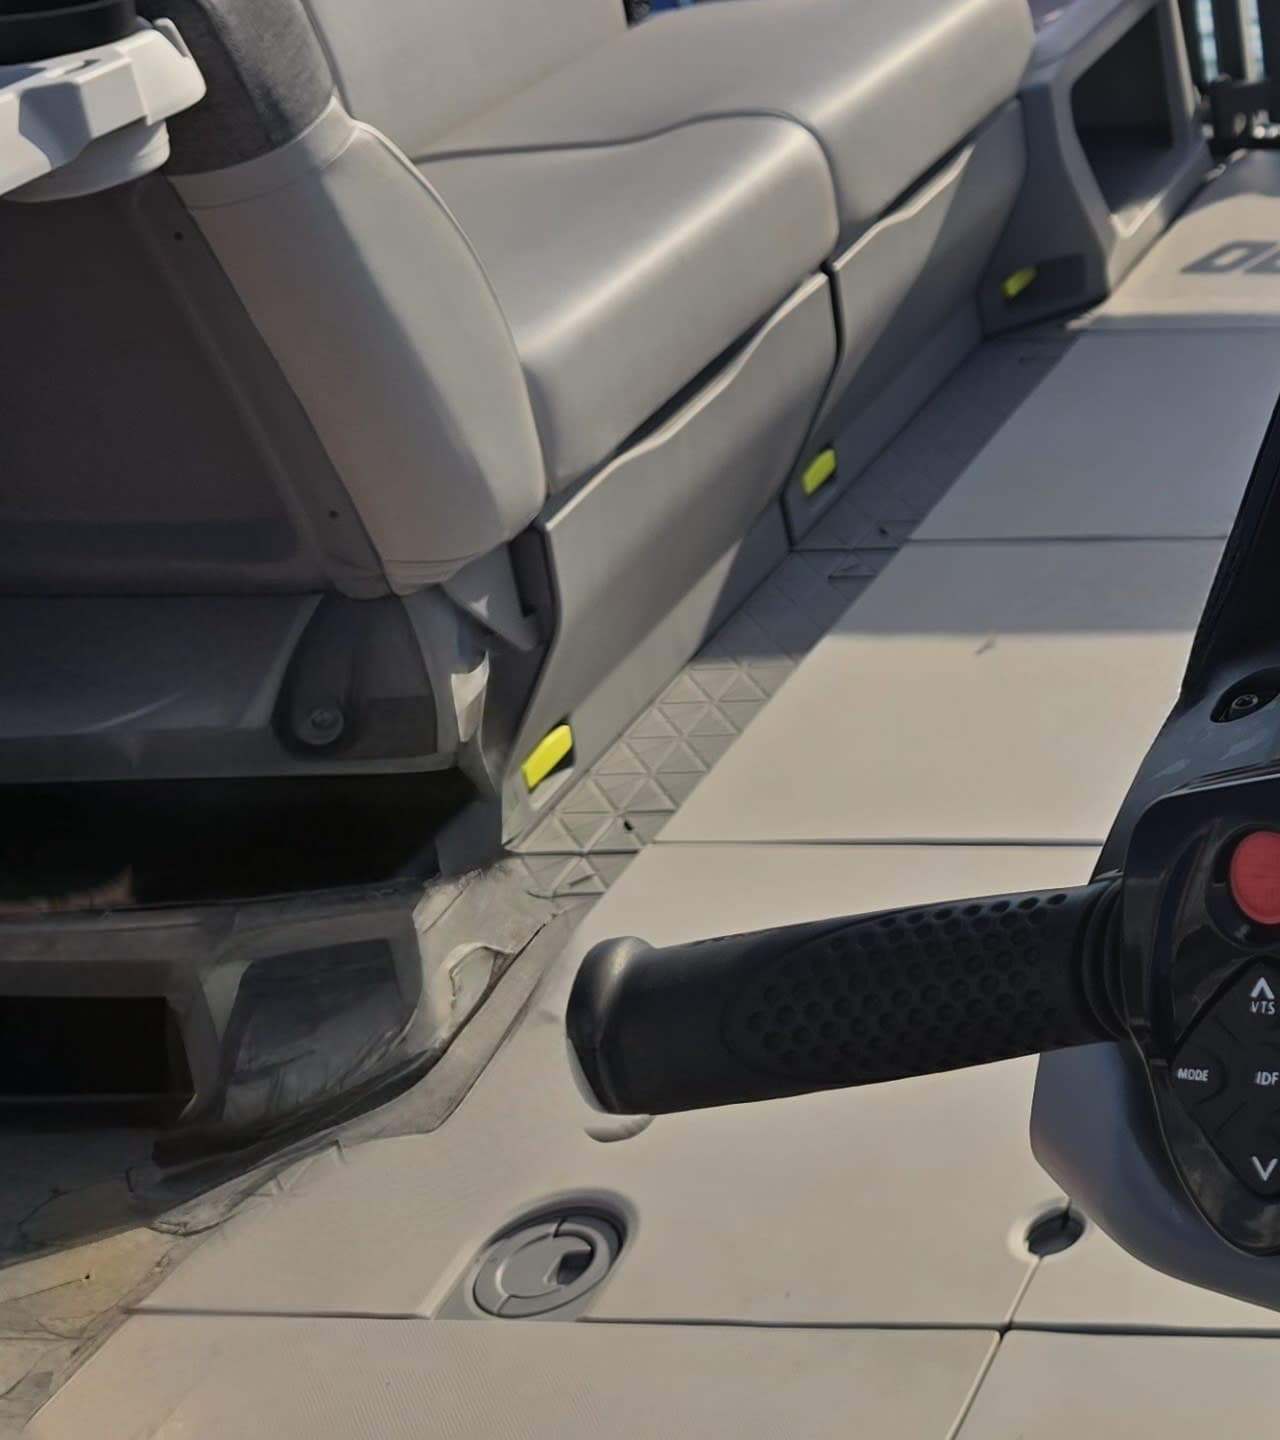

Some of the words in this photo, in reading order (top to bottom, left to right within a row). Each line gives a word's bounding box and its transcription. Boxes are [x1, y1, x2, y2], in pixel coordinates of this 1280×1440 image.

[1251, 1000, 1275, 1015] VTS
[1177, 1067, 1209, 1082] MODE
[1255, 1071, 1280, 1086] IDF
